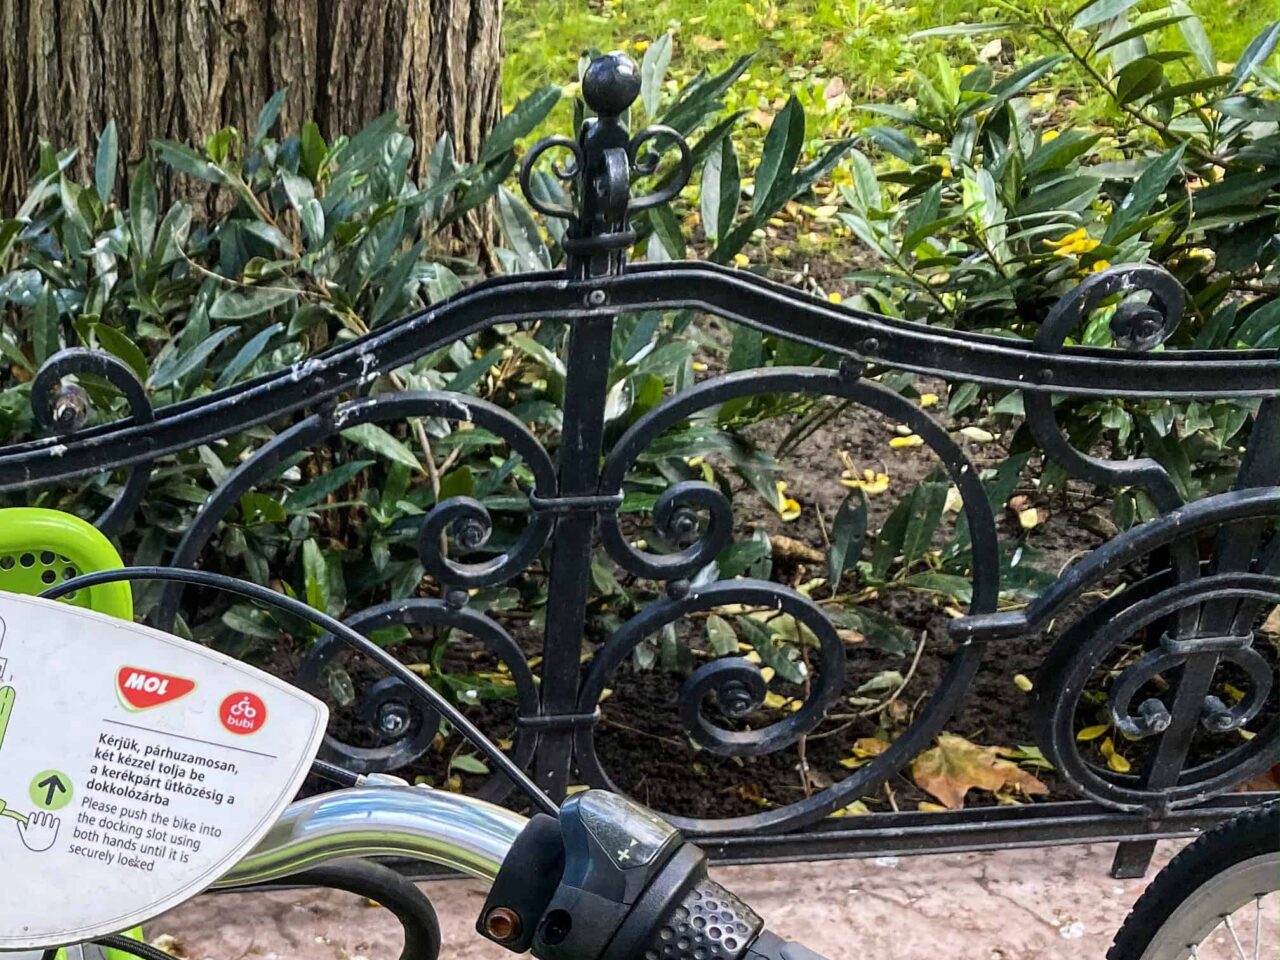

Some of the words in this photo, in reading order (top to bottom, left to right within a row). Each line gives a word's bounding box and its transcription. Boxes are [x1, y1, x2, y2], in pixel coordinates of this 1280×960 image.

[124, 672, 170, 695] MOL
[227, 714, 254, 729] bubi
[94, 747, 114, 762] két
[117, 752, 155, 771] kézzel
[158, 762, 186, 780] tolja
[190, 770, 206, 782] be
[98, 733, 140, 754] Kérjük,
[144, 744, 239, 776] párhuzamosan,
[86, 778, 170, 806] dokkolózárba
[90, 765, 98, 774] a
[101, 764, 162, 789] kerékpárt
[227, 795, 236, 805] a
[77, 812, 96, 826] the
[98, 816, 144, 839] docking
[146, 828, 168, 842] slot
[170, 835, 201, 852] using
[81, 796, 118, 814] Please
[119, 806, 148, 822] push
[151, 813, 170, 826] the
[172, 816, 197, 832] bike
[199, 822, 222, 838] into
[68, 844, 116, 866] securely
[73, 826, 100, 842] both
[102, 833, 137, 851] hands
[140, 843, 166, 858] until
[168, 850, 178, 861] it
[180, 852, 190, 864] is
